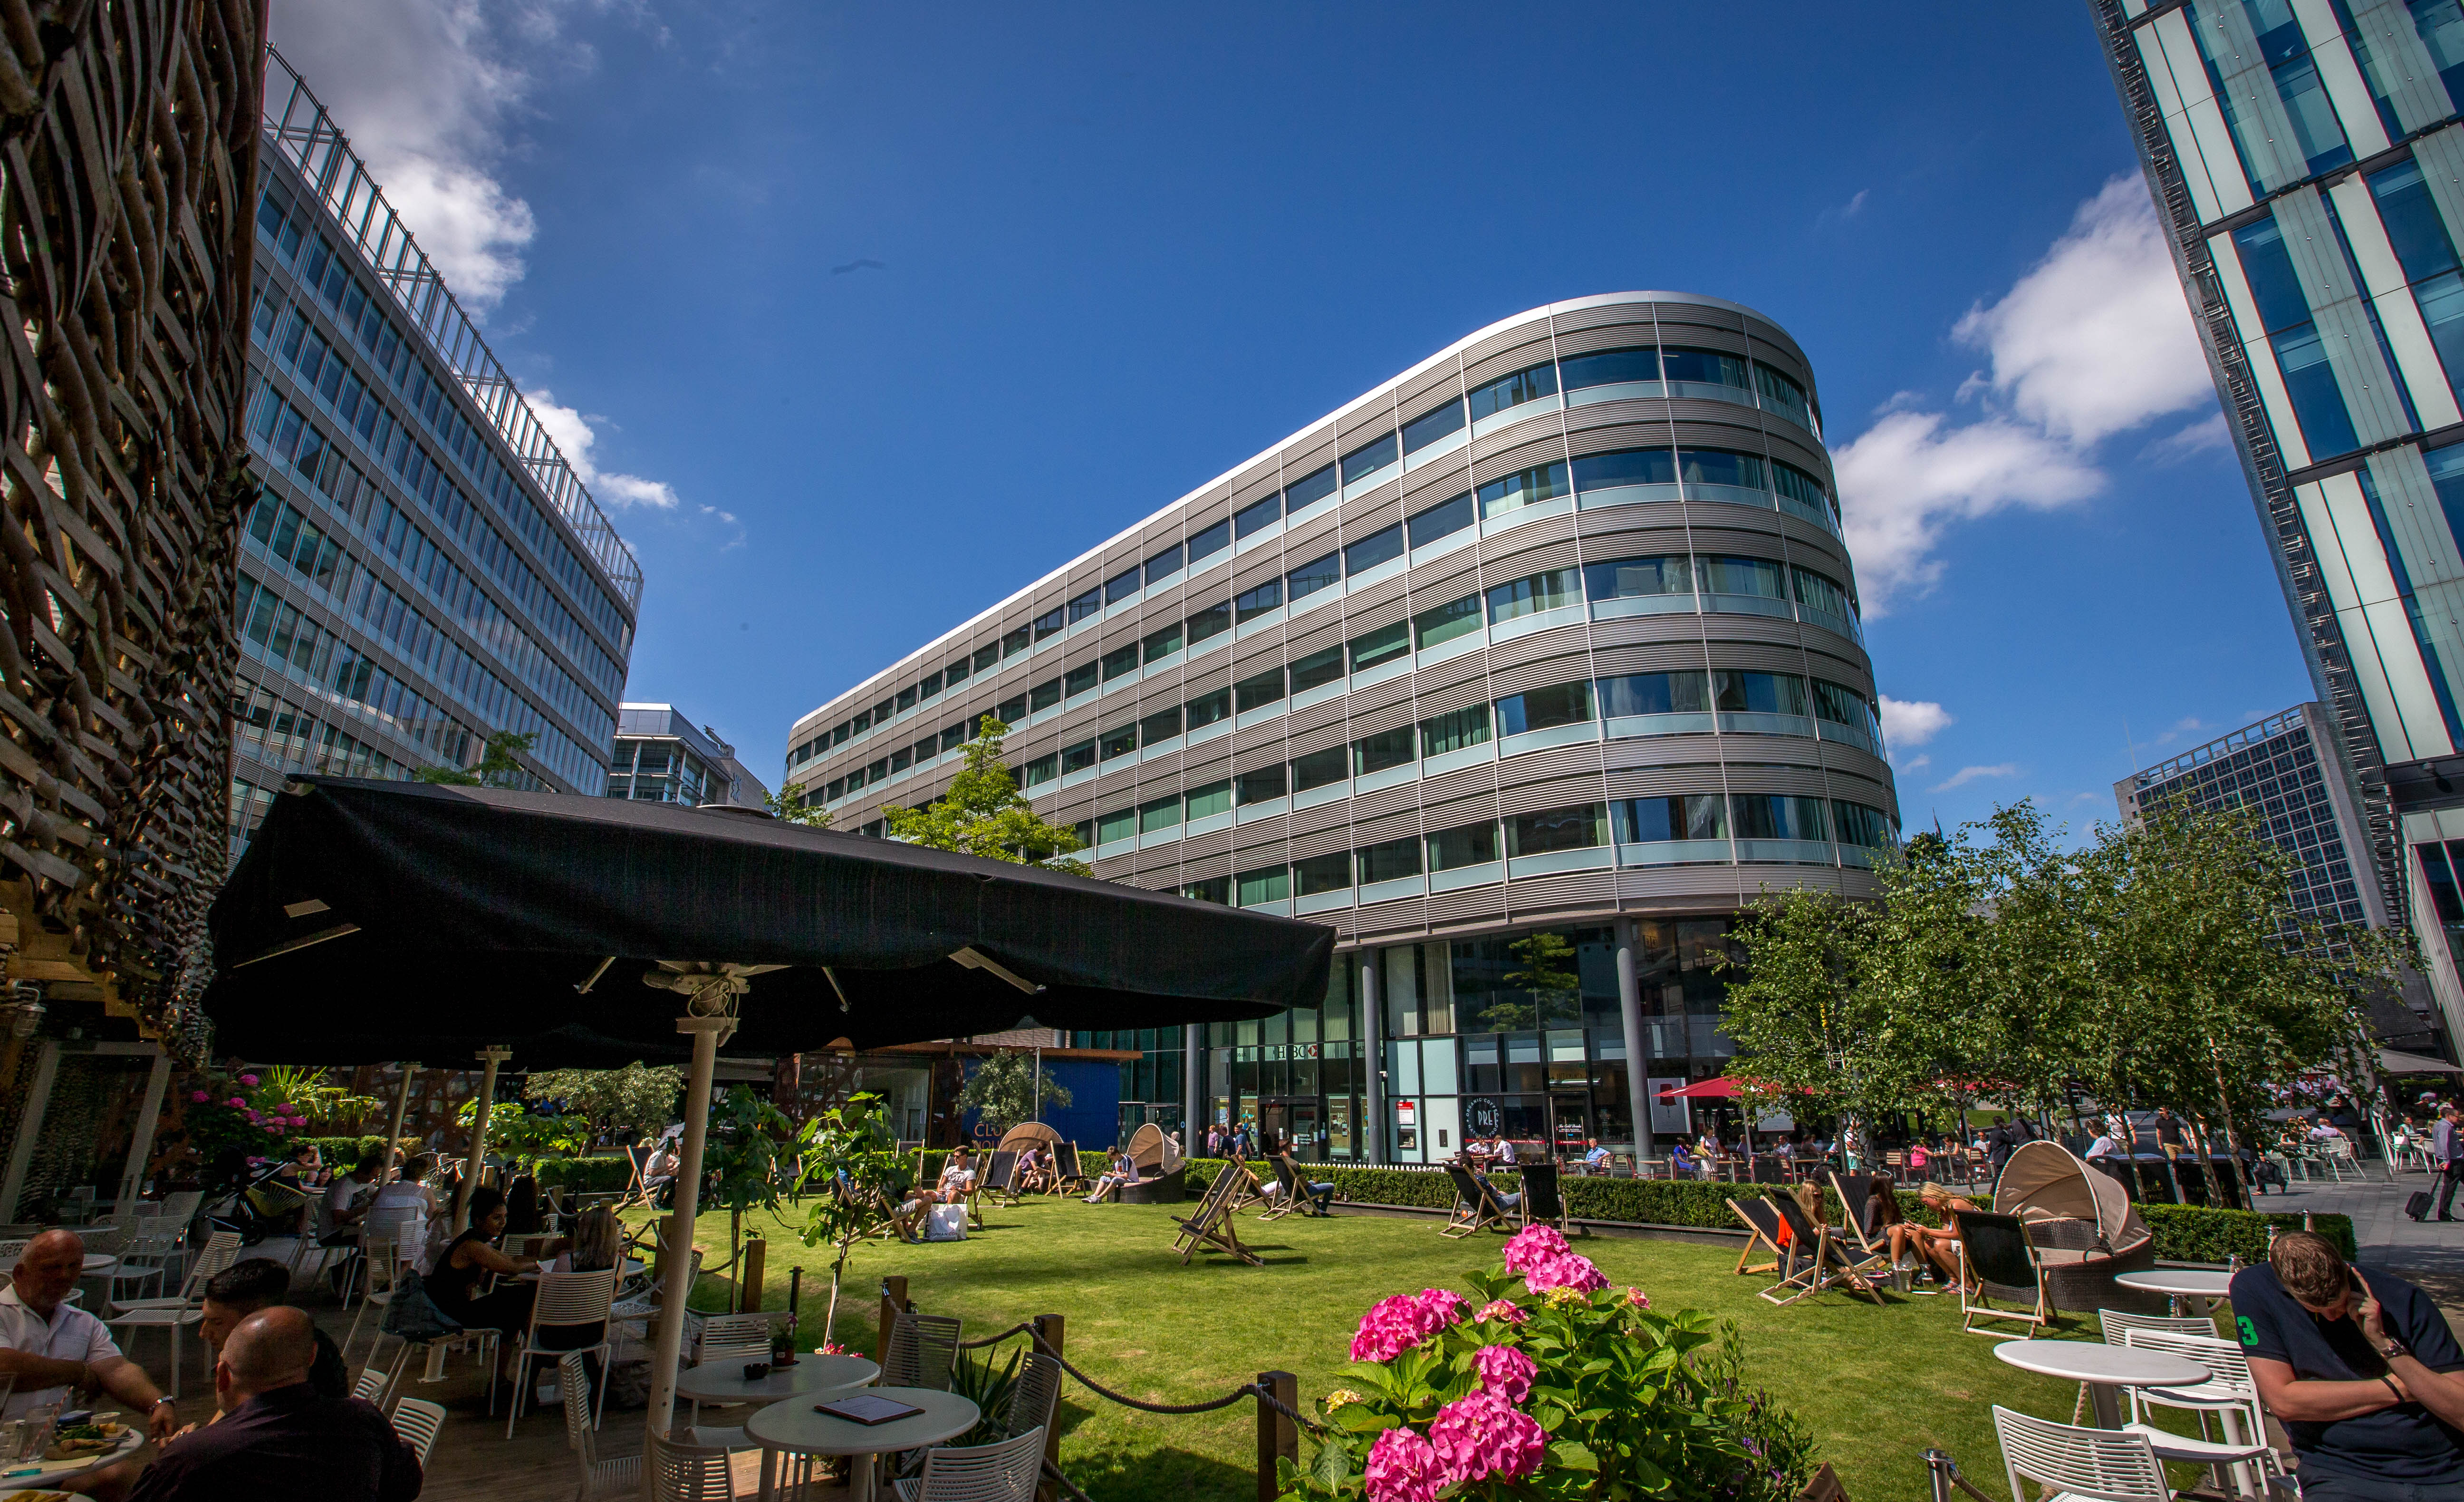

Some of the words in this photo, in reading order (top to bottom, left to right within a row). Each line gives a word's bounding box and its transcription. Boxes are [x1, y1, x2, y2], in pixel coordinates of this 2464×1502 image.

[1278, 1046, 1306, 1058] HBC
[1466, 1098, 1482, 1117] ORGANIC
[1483, 1098, 1499, 1117] COFFEE
[1478, 1110, 1496, 1125] PRET
[974, 1124, 1002, 1137] CLU
[1489, 1124, 1498, 1137] FOOD
[2237, 1316, 2258, 1346] 3
